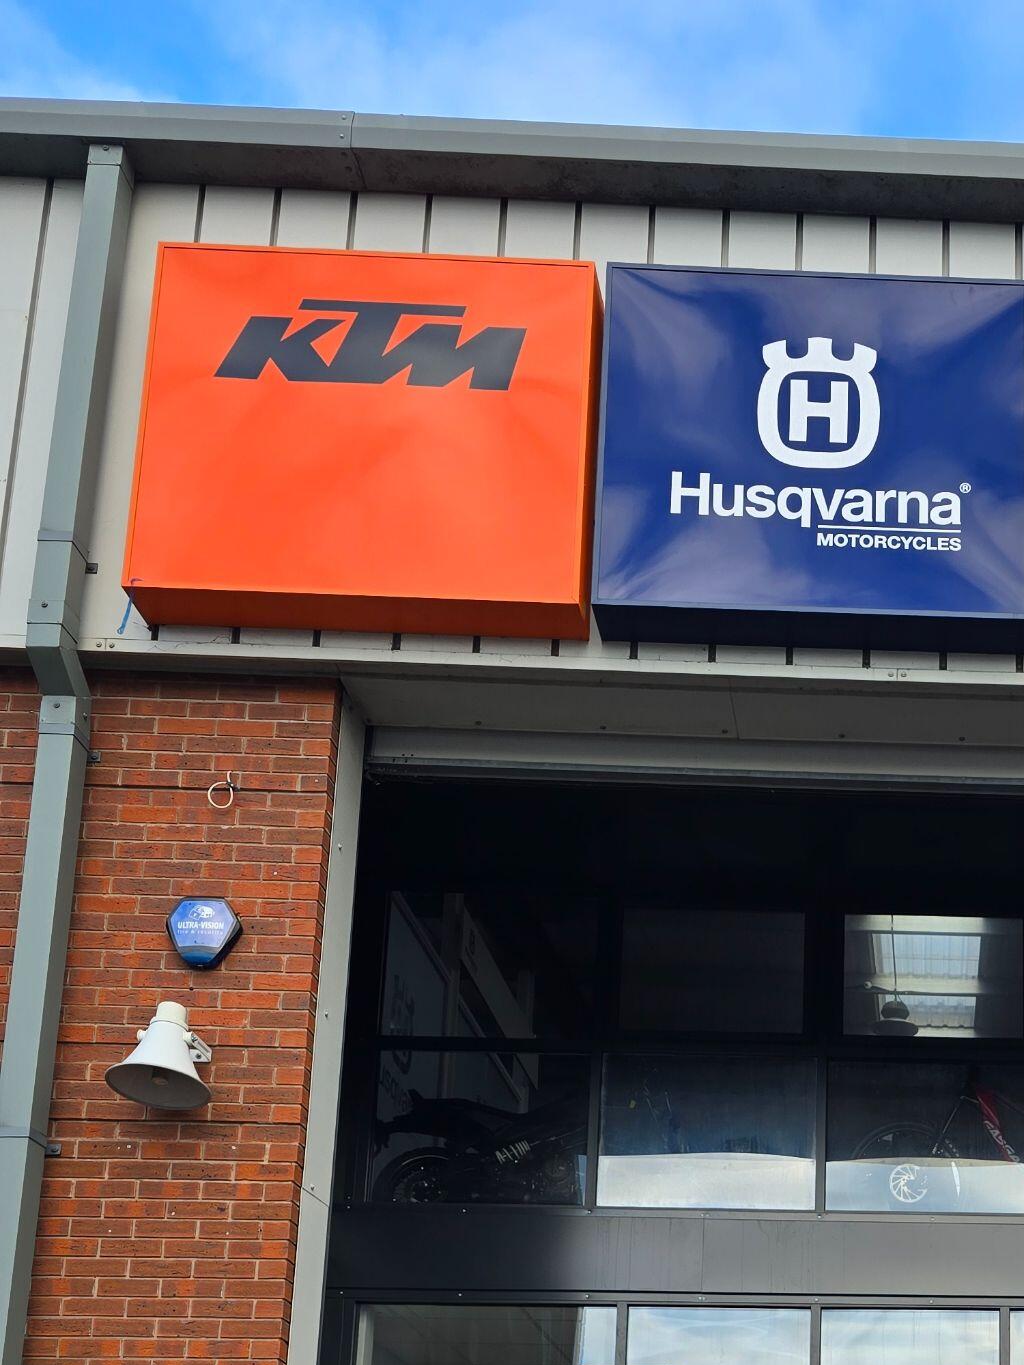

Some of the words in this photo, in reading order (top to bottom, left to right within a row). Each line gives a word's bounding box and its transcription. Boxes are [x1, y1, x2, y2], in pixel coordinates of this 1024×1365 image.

[213, 298, 527, 391] KTM
[816, 532, 962, 551] MOTORCYCLES
[177, 921, 225, 930] ULTRA-VISION
